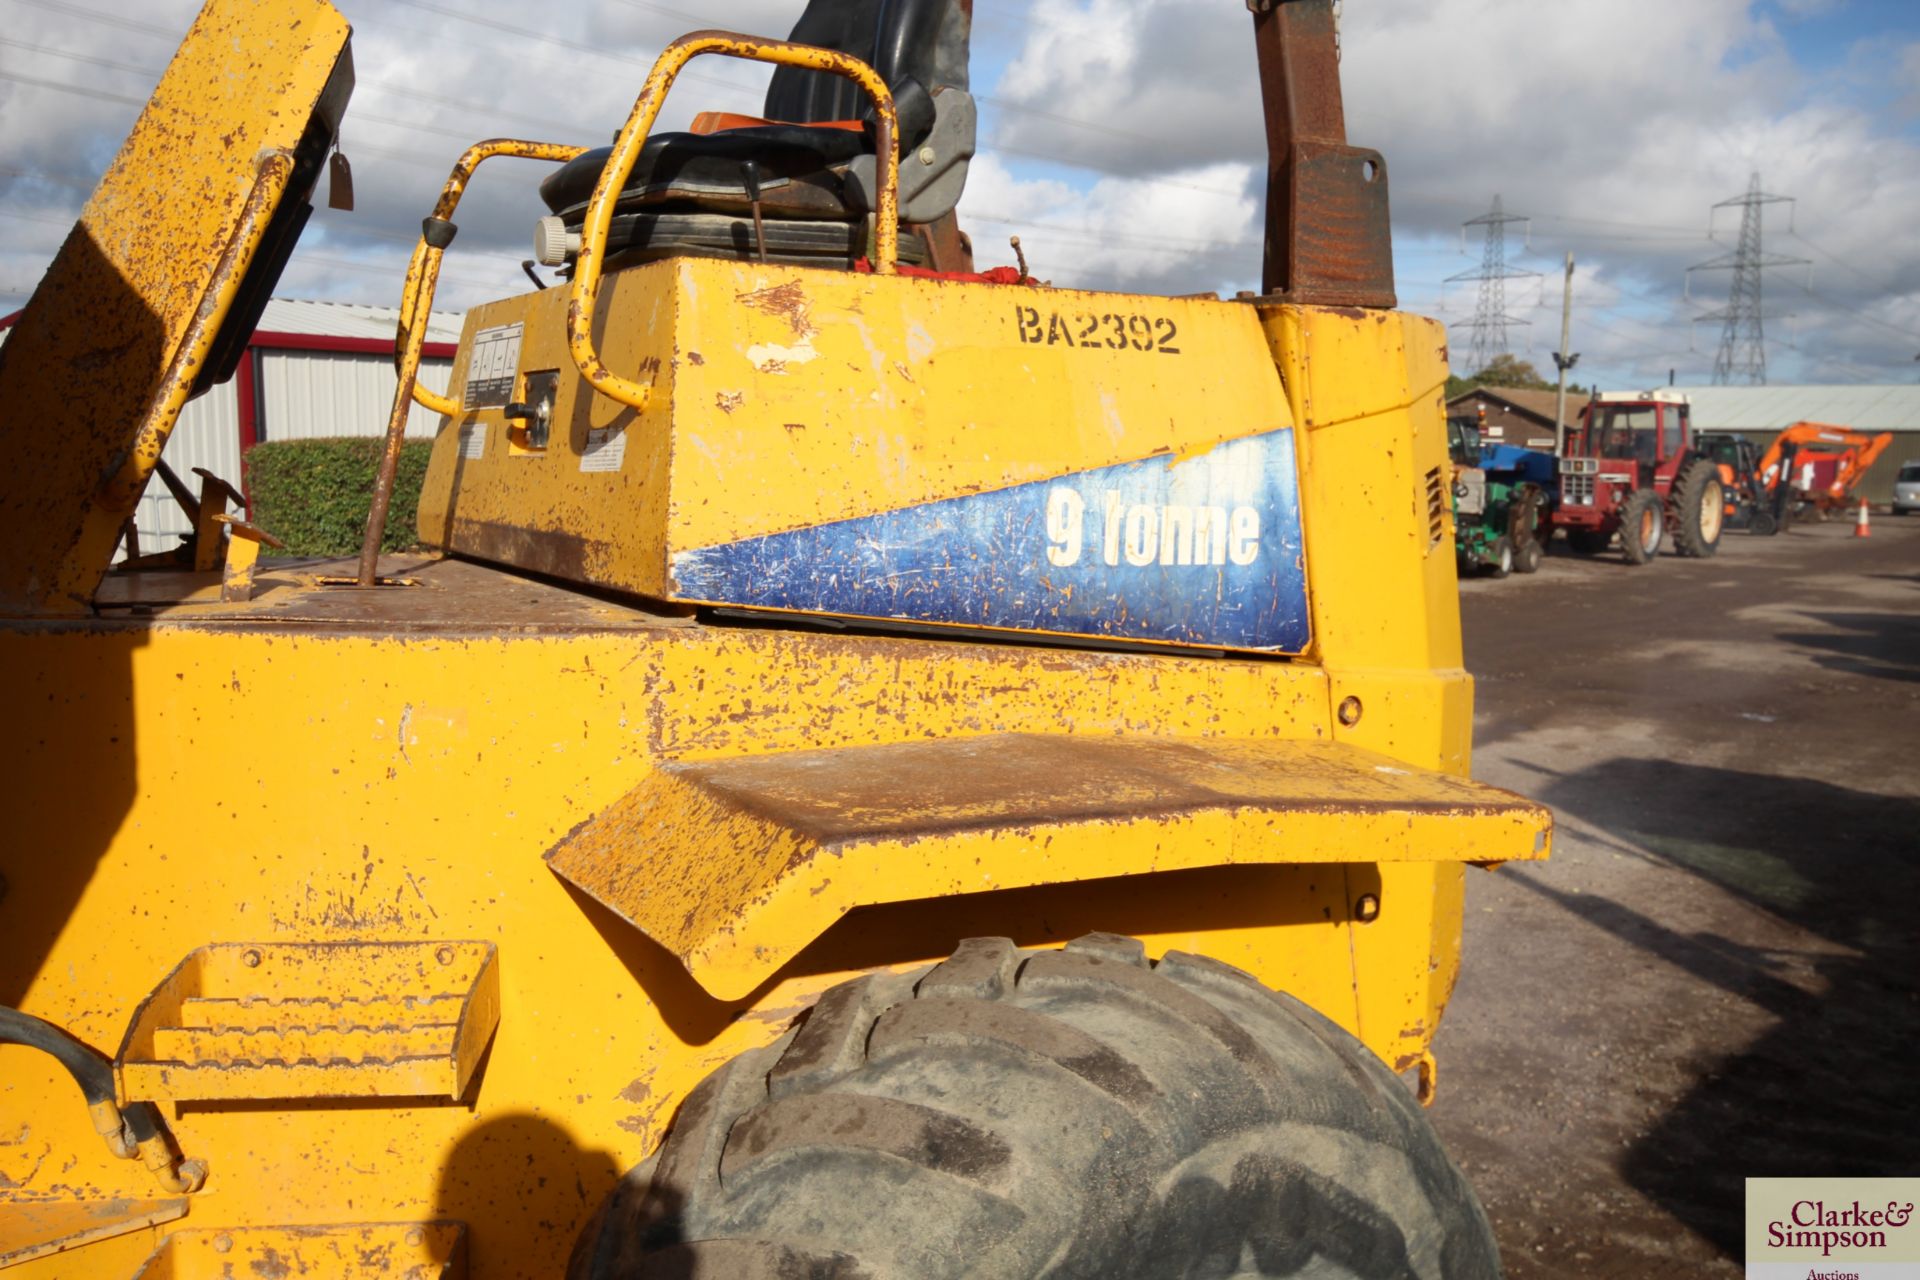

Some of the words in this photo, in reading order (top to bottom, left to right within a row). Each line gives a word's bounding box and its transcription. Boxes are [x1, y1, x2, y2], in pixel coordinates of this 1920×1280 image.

[1017, 305, 1180, 354] BA2392
[1046, 488, 1084, 567] 9
[1103, 489, 1260, 567] tonne
